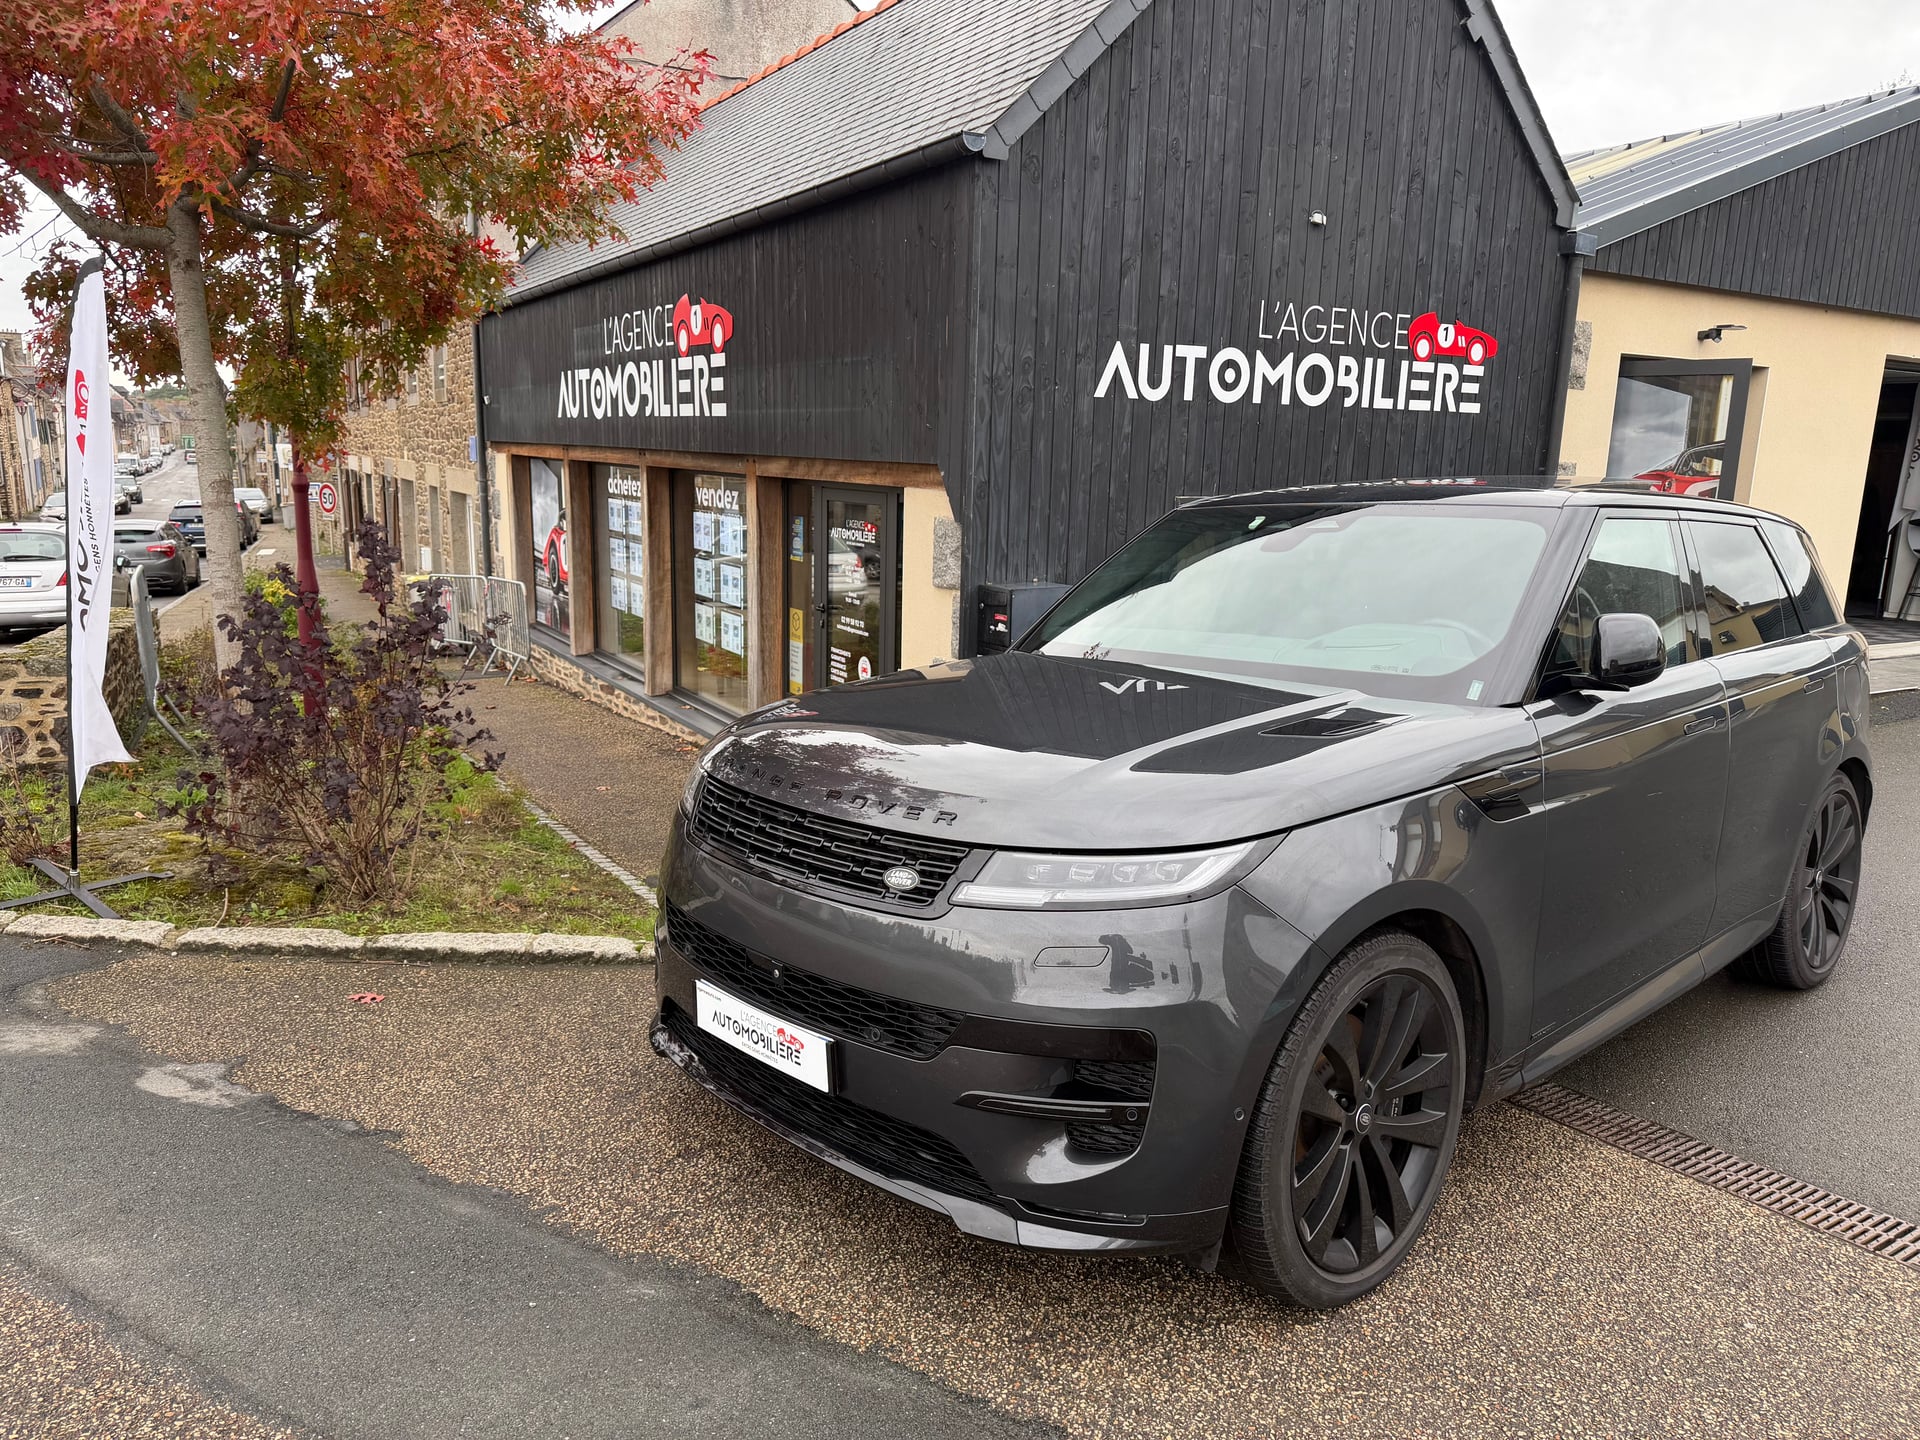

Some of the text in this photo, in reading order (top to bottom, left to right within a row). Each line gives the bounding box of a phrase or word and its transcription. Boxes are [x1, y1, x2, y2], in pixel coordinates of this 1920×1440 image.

[604, 304, 675, 355] L'AGENCE
[693, 309, 698, 329] 1
[1259, 300, 1411, 349] L'AGENCE
[1443, 326, 1450, 342] 1
[608, 469, 641, 496] achetez
[695, 477, 739, 510] vendez
[322, 492, 333, 504] 50
[824, 789, 959, 827] ROVER
[889, 877, 912, 886] ROVER
[890, 870, 908, 878] LAND
[740, 1009, 777, 1038] L'AGENCE
